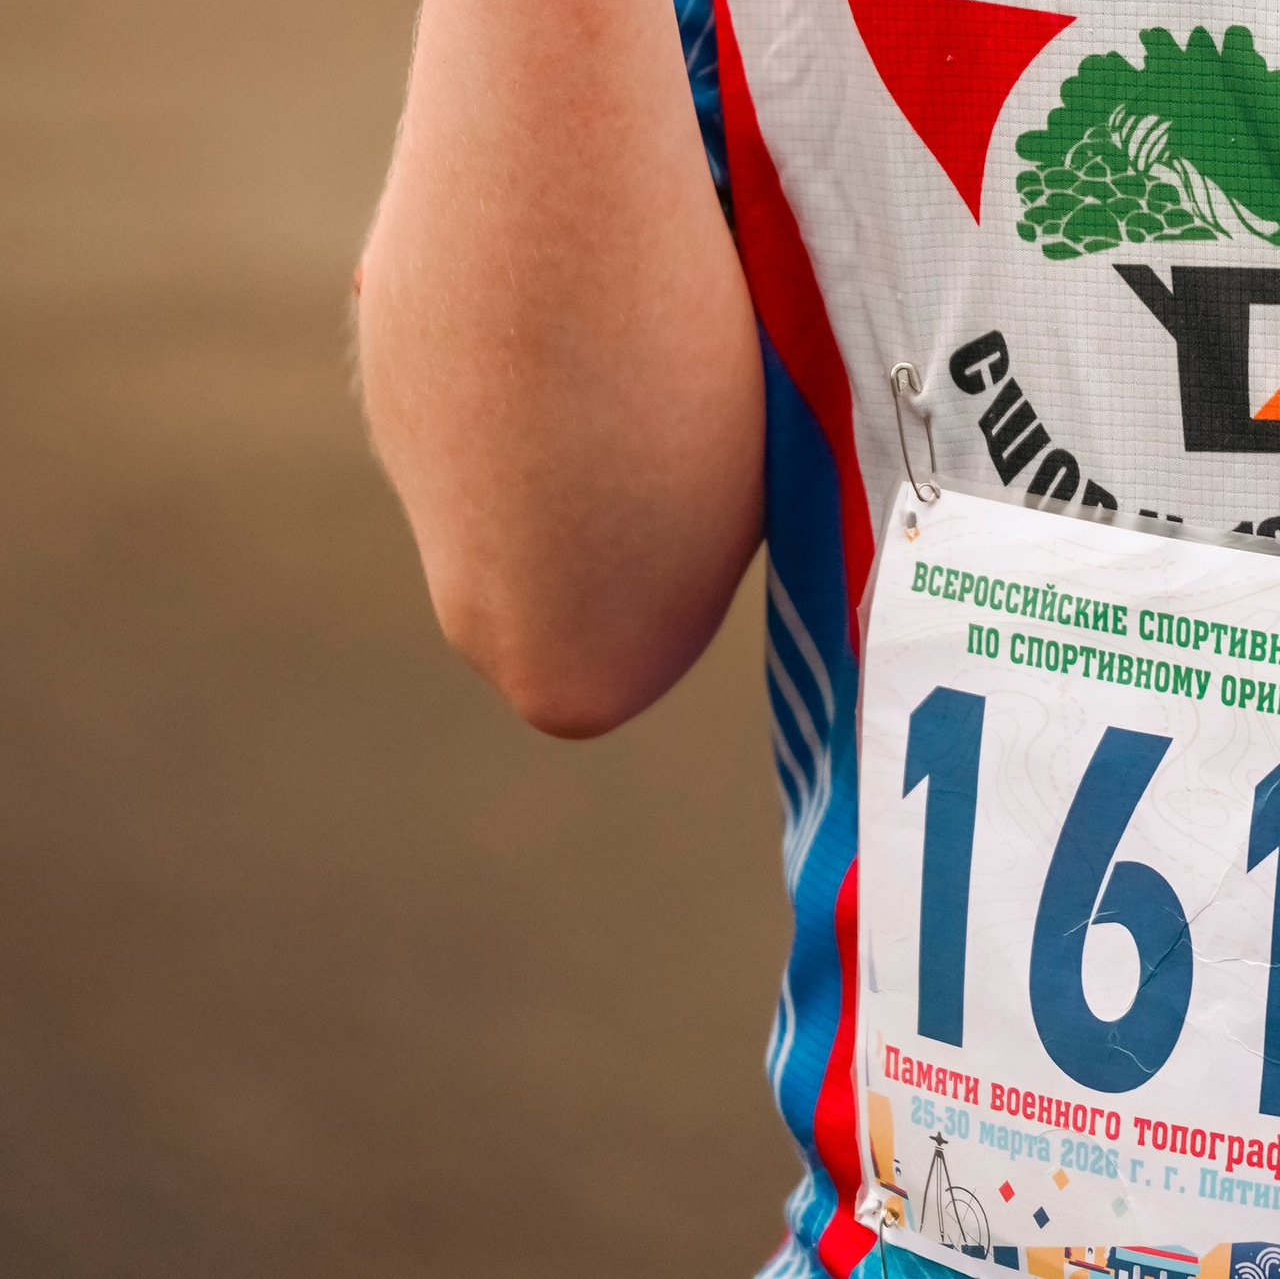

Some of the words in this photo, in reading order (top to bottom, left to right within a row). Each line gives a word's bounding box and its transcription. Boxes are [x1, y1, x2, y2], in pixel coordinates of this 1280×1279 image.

[911, 560, 1129, 636] ВСЕРОССИЙСКИЕ
[967, 623, 1001, 659] ПО
[1010, 632, 1211, 701] СПОРТИВНОМУ
[884, 1044, 980, 1105] Памяти
[990, 1084, 1122, 1141] военного
[910, 1095, 971, 1141] 25-30
[978, 1122, 1052, 1166] марта
[1130, 1163, 1153, 1188] г.
[1163, 1169, 1187, 1196] г.
